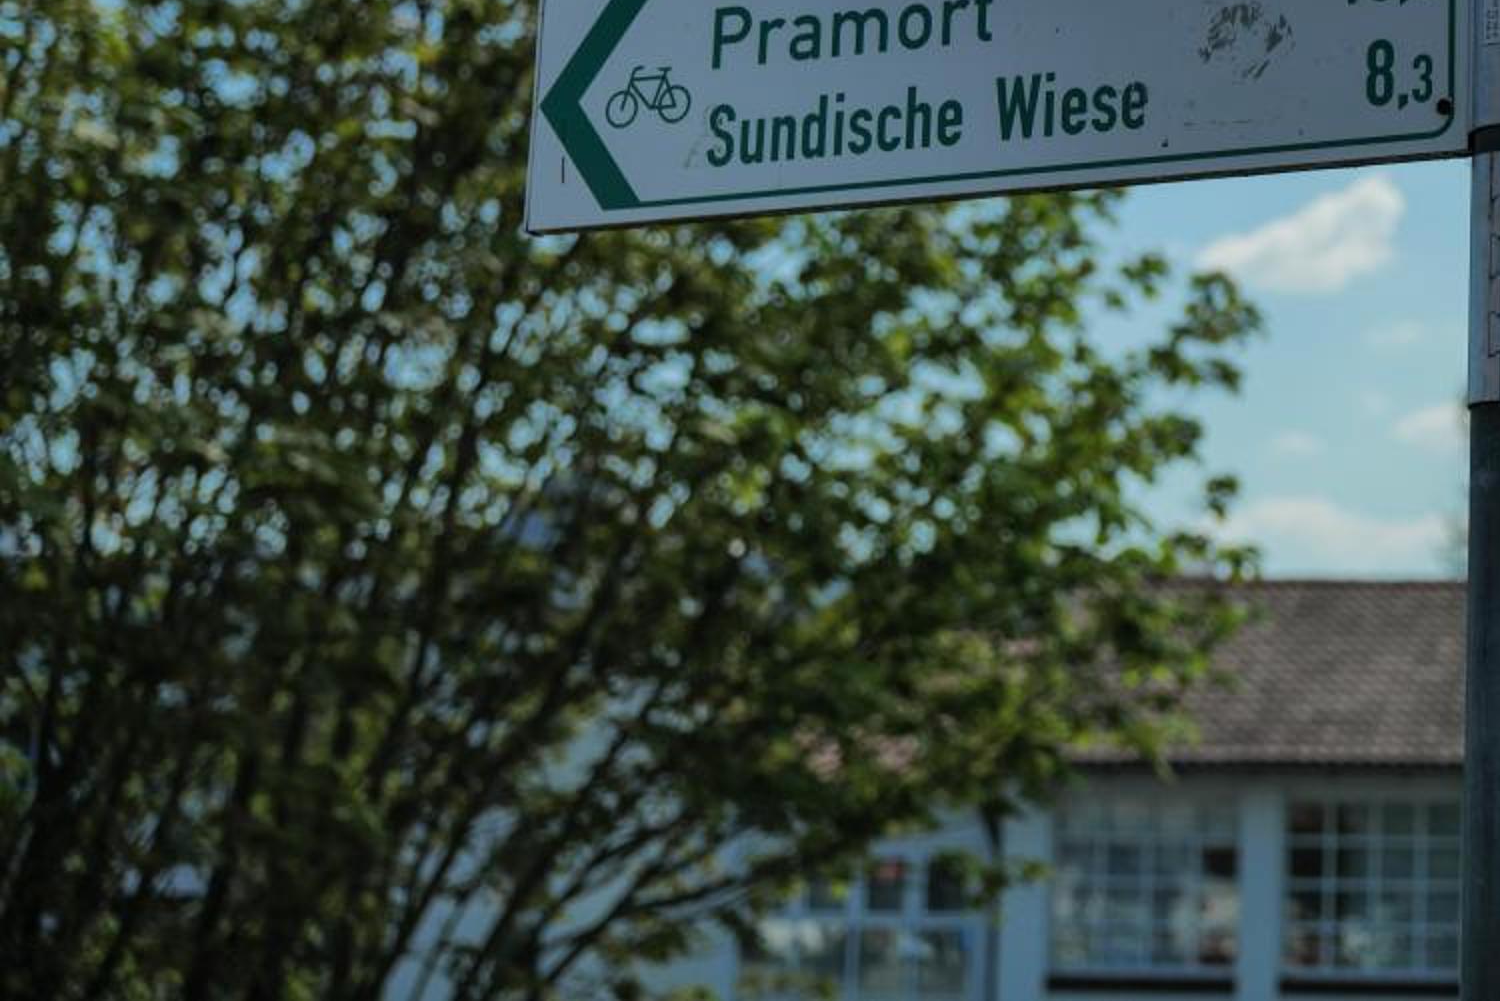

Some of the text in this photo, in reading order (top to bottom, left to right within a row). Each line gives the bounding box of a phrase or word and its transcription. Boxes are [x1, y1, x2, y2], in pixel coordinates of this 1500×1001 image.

[707, 38, 1433, 168] Sundische Wiese 8,3
